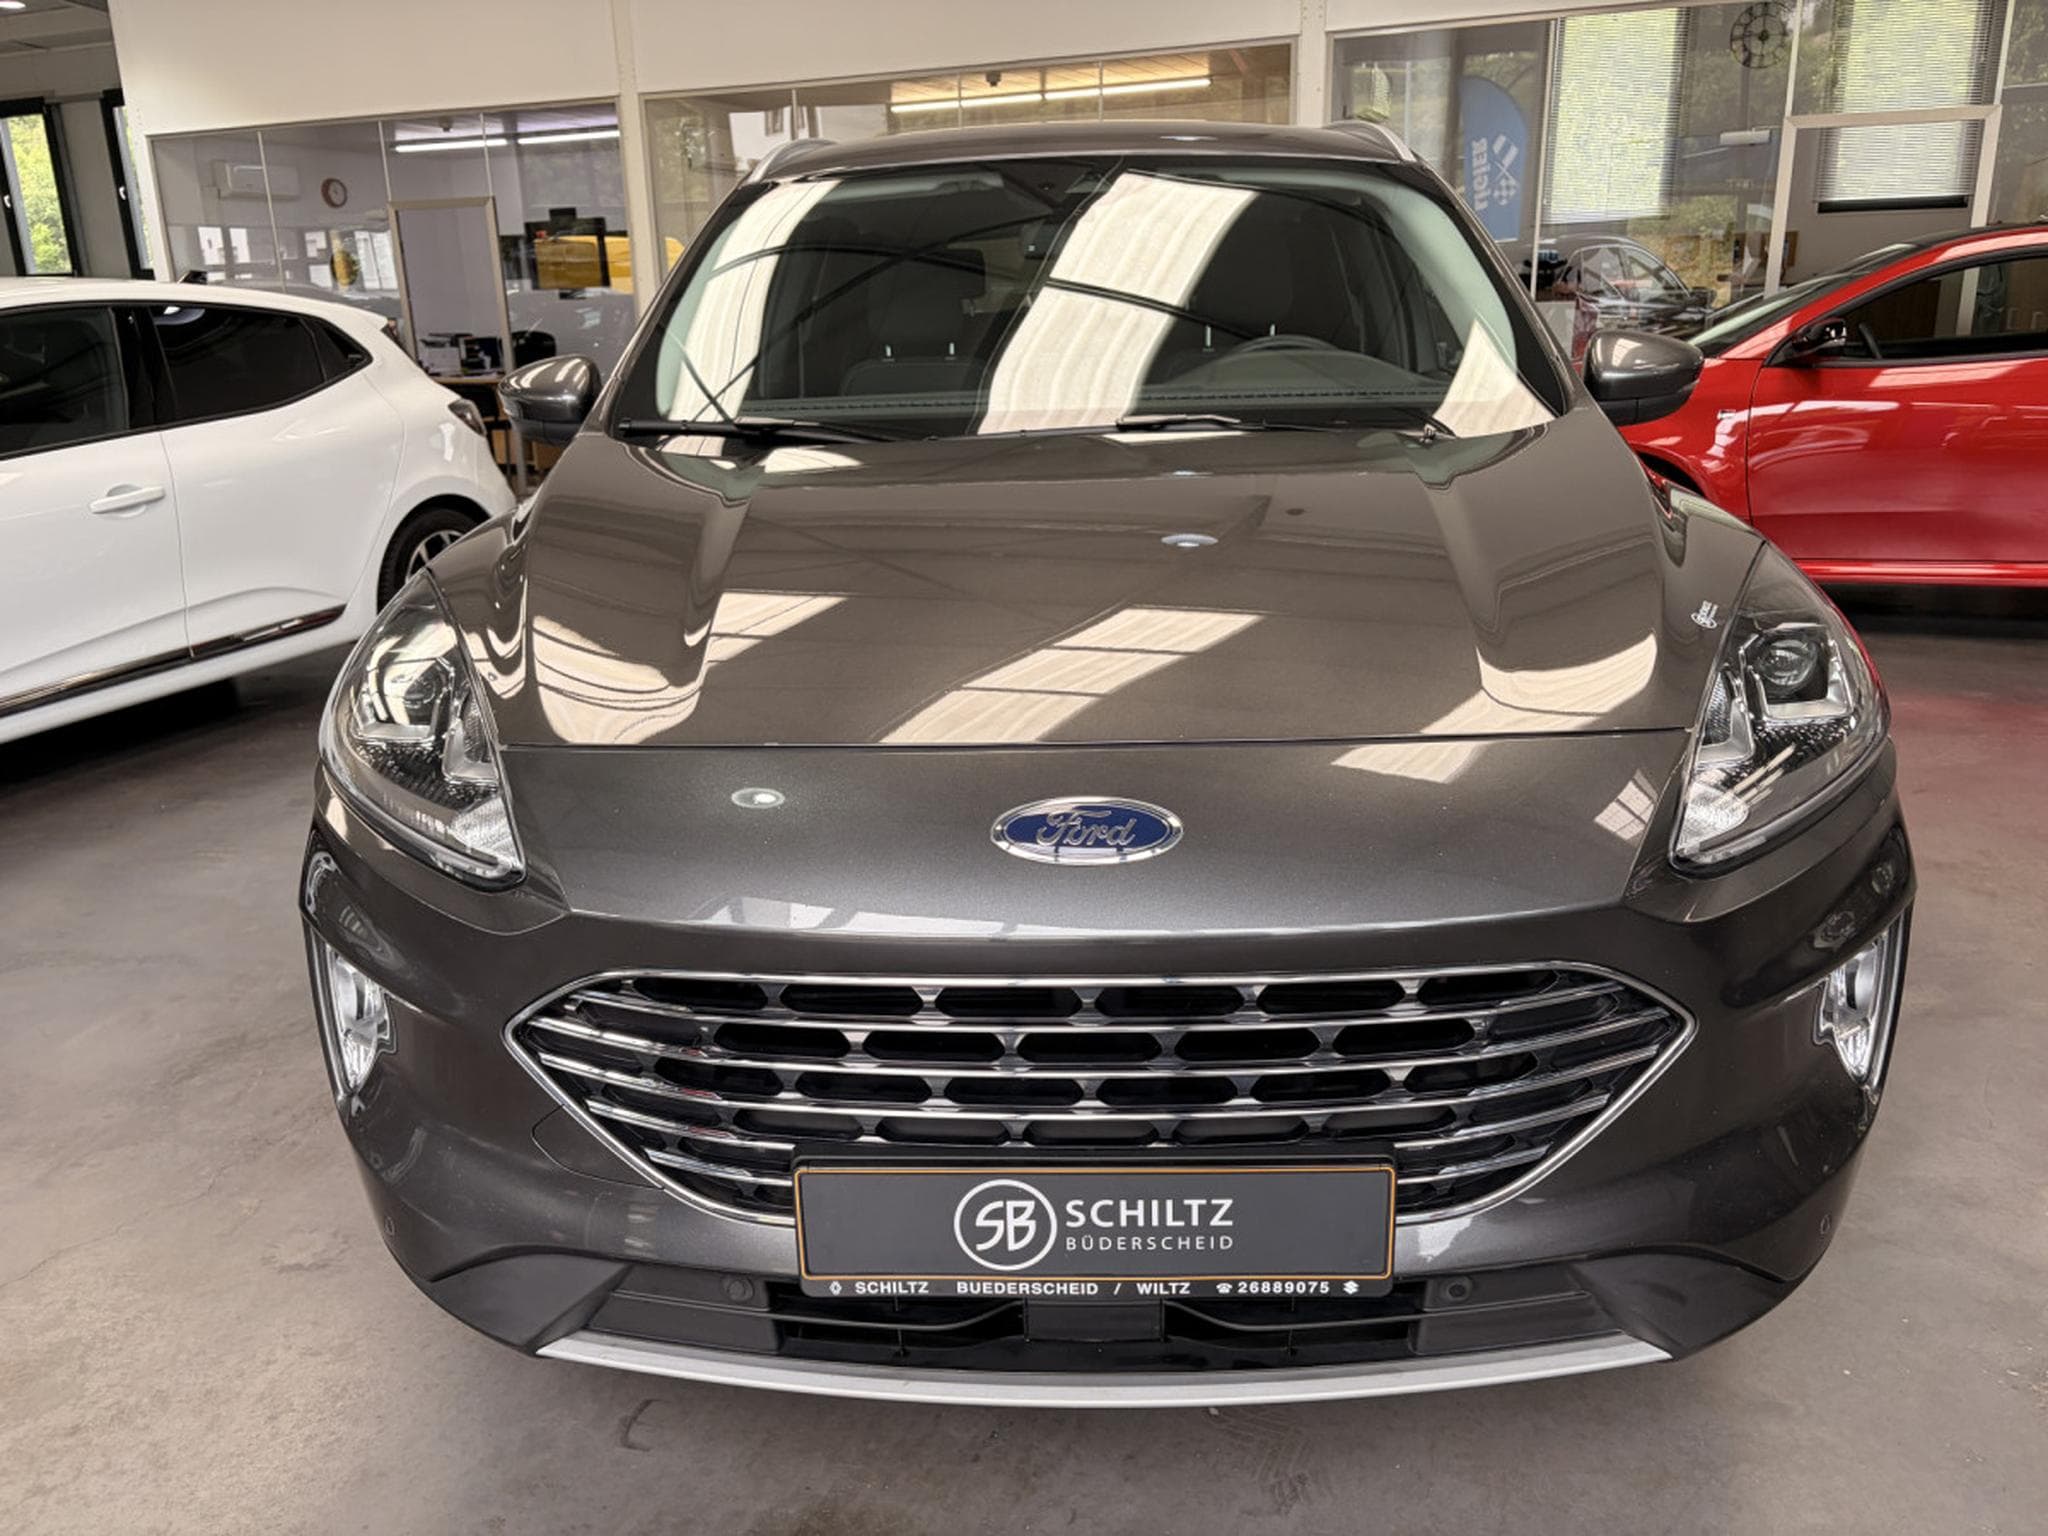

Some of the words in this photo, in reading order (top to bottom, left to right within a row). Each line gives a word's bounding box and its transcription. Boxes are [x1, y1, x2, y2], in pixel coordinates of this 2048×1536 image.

[1036, 808, 1138, 847] Ford
[1065, 1199, 1234, 1228] SCHILTZ
[1065, 1235, 1234, 1251] BÜDERSCHEID
[855, 1281, 930, 1295] SCHILTZ
[956, 1281, 1099, 1296] BUEDERSCHEID
[1136, 1282, 1191, 1296] WILTZ
[1237, 1281, 1331, 1294] 26889075
